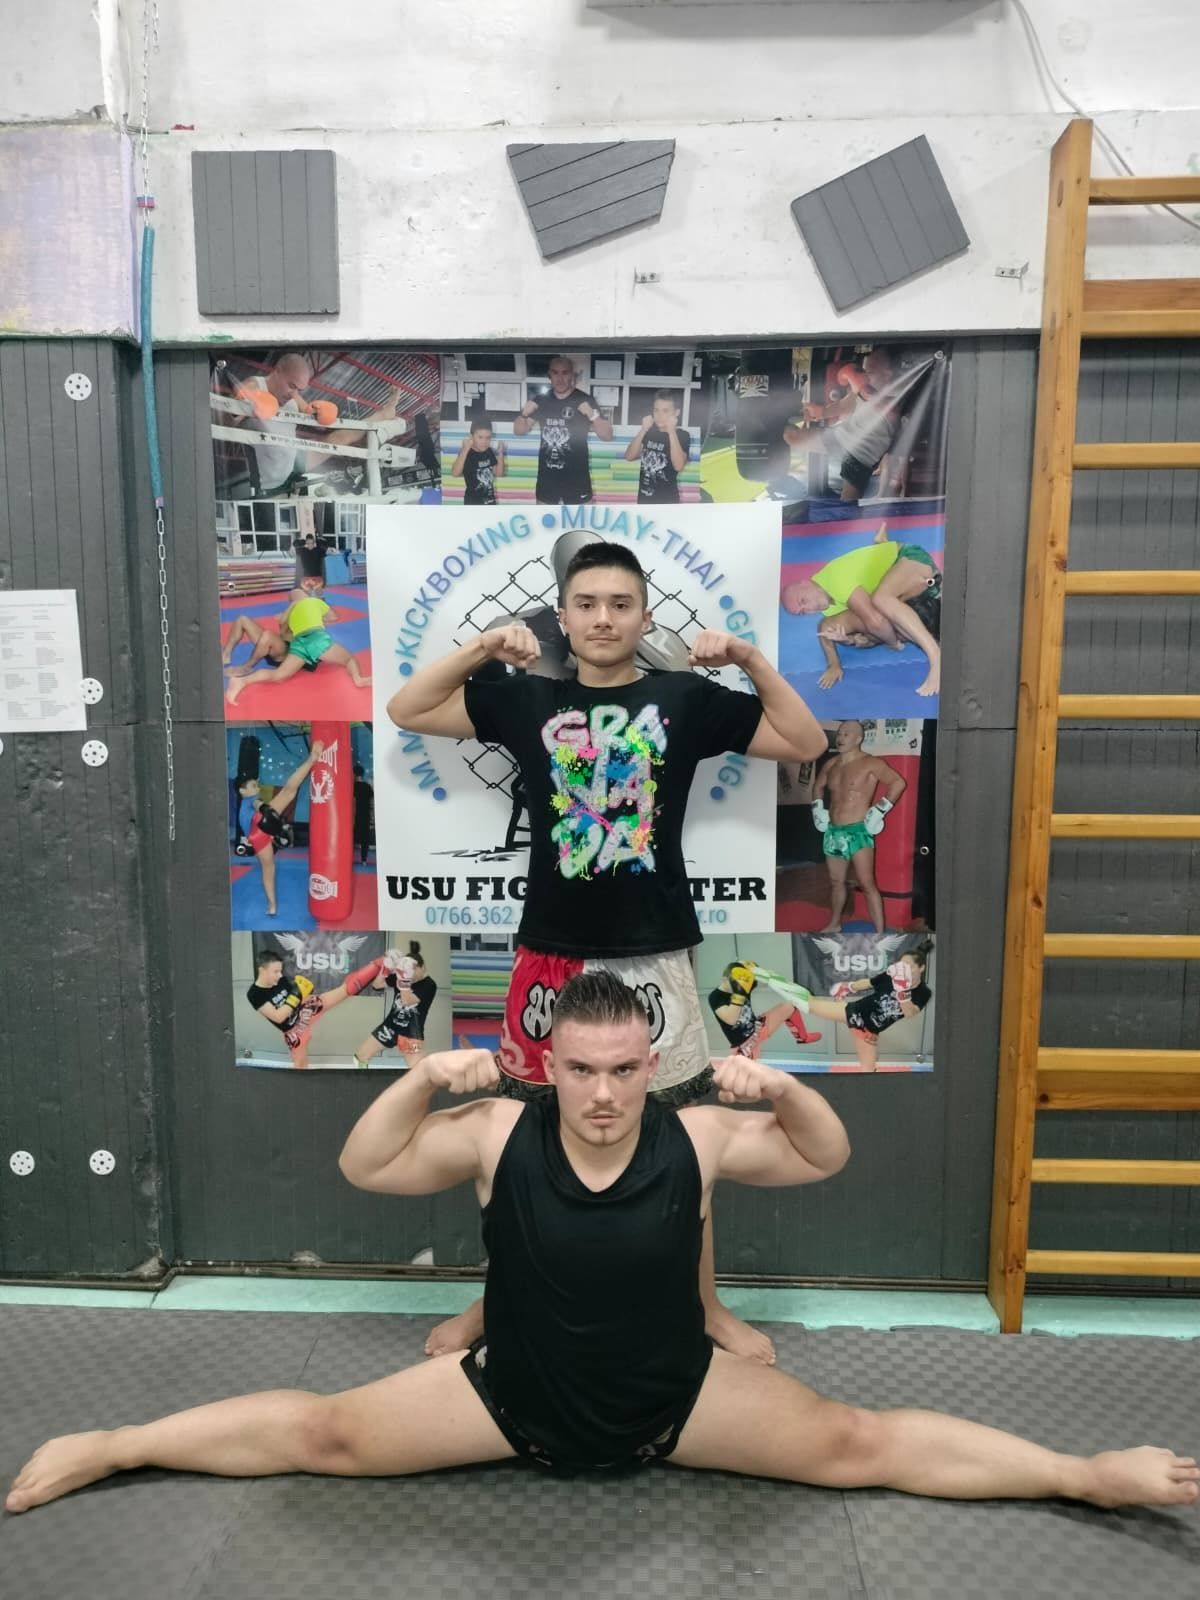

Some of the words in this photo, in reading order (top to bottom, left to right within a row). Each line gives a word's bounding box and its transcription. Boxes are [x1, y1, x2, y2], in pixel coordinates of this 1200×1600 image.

[561, 505, 724, 591] MUAY-THAI
[395, 513, 532, 659] KICKBOXING
[386, 875, 456, 901] USU
[466, 875, 528, 901] FIG
[687, 876, 767, 902] TER
[425, 905, 523, 925] 0766.362.
[296, 952, 345, 970] USU
[834, 954, 884, 972] USU
